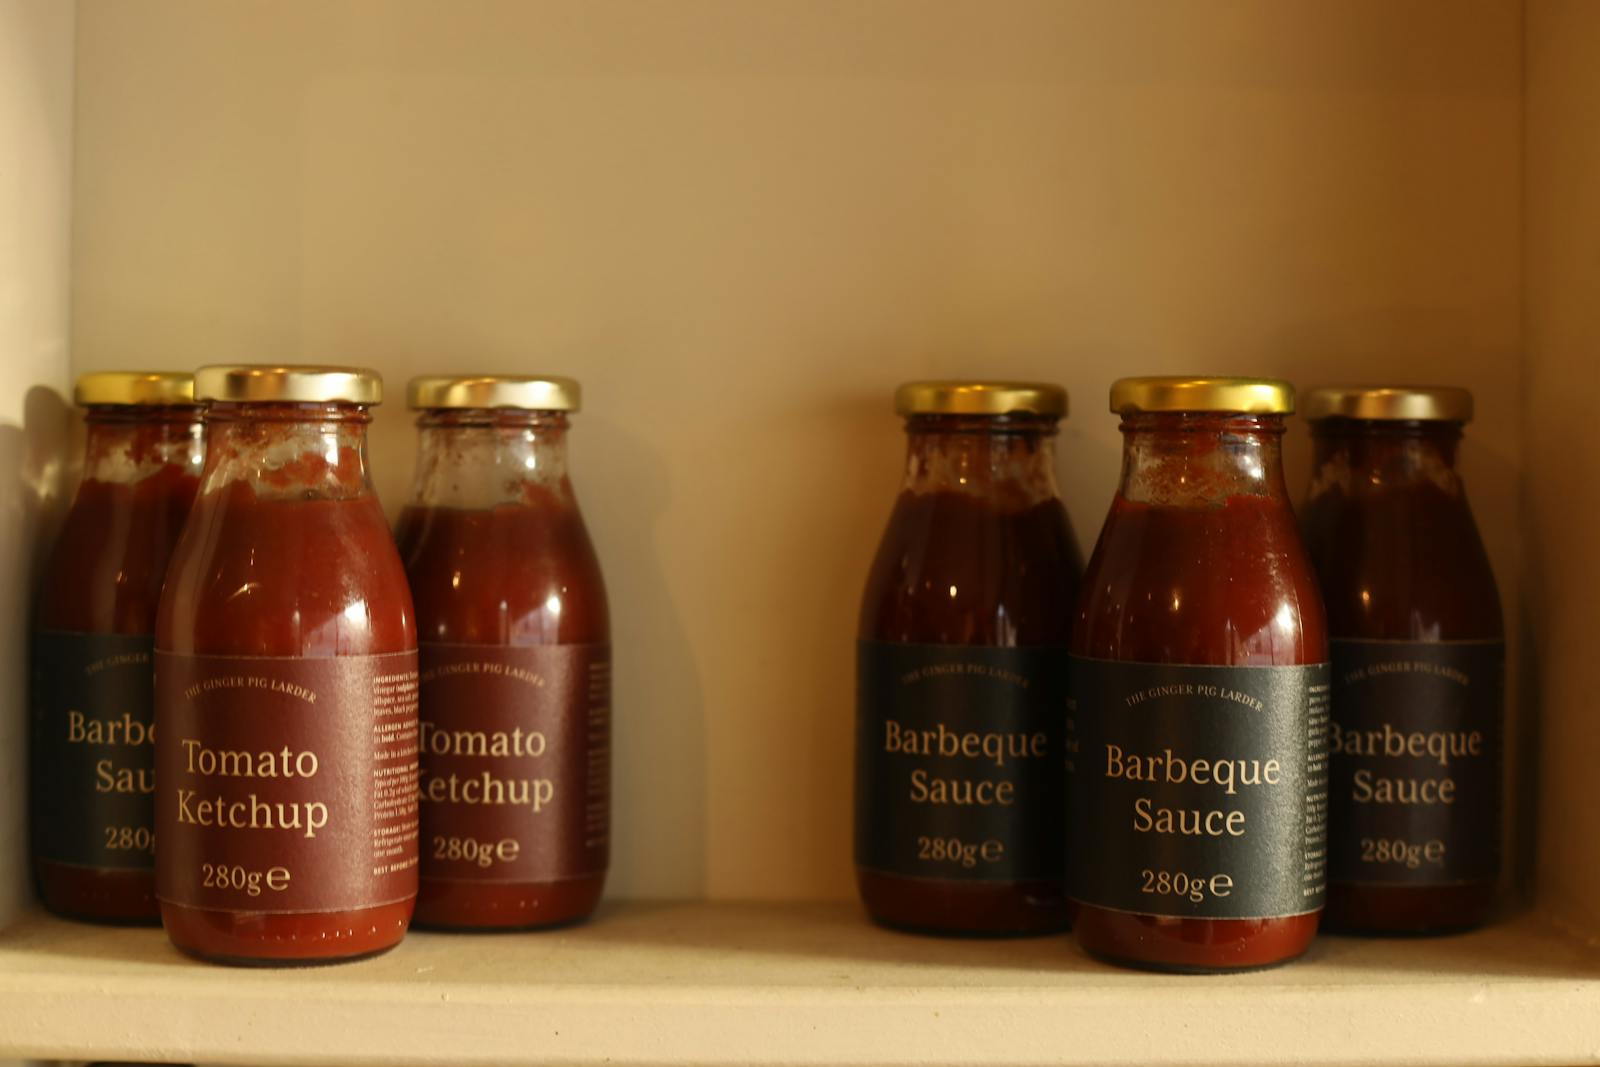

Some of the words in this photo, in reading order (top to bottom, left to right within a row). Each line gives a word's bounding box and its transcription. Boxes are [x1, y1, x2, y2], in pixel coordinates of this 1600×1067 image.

[185, 680, 200, 700] THE
[203, 677, 244, 691] GINGER
[248, 677, 268, 690] PIG
[271, 679, 317, 704] LARDER
[483, 662, 502, 674] PIG
[505, 665, 546, 688] LARDER
[1125, 692, 1145, 707] THE
[1148, 684, 1194, 698] GINGER
[1197, 684, 1217, 697] PIG
[1220, 687, 1265, 712] LARDER
[419, 722, 546, 757] Tomato
[885, 719, 1048, 767] Barbeque
[1328, 722, 1482, 766] Barbeque
[181, 739, 319, 778] Tomato
[1105, 744, 1281, 795] Barbeque
[910, 769, 1014, 805] Sauce
[1353, 769, 1456, 805] Sauce
[177, 789, 329, 838] Ketchup
[1134, 798, 1246, 837] Sauce
[105, 826, 155, 855] 280
